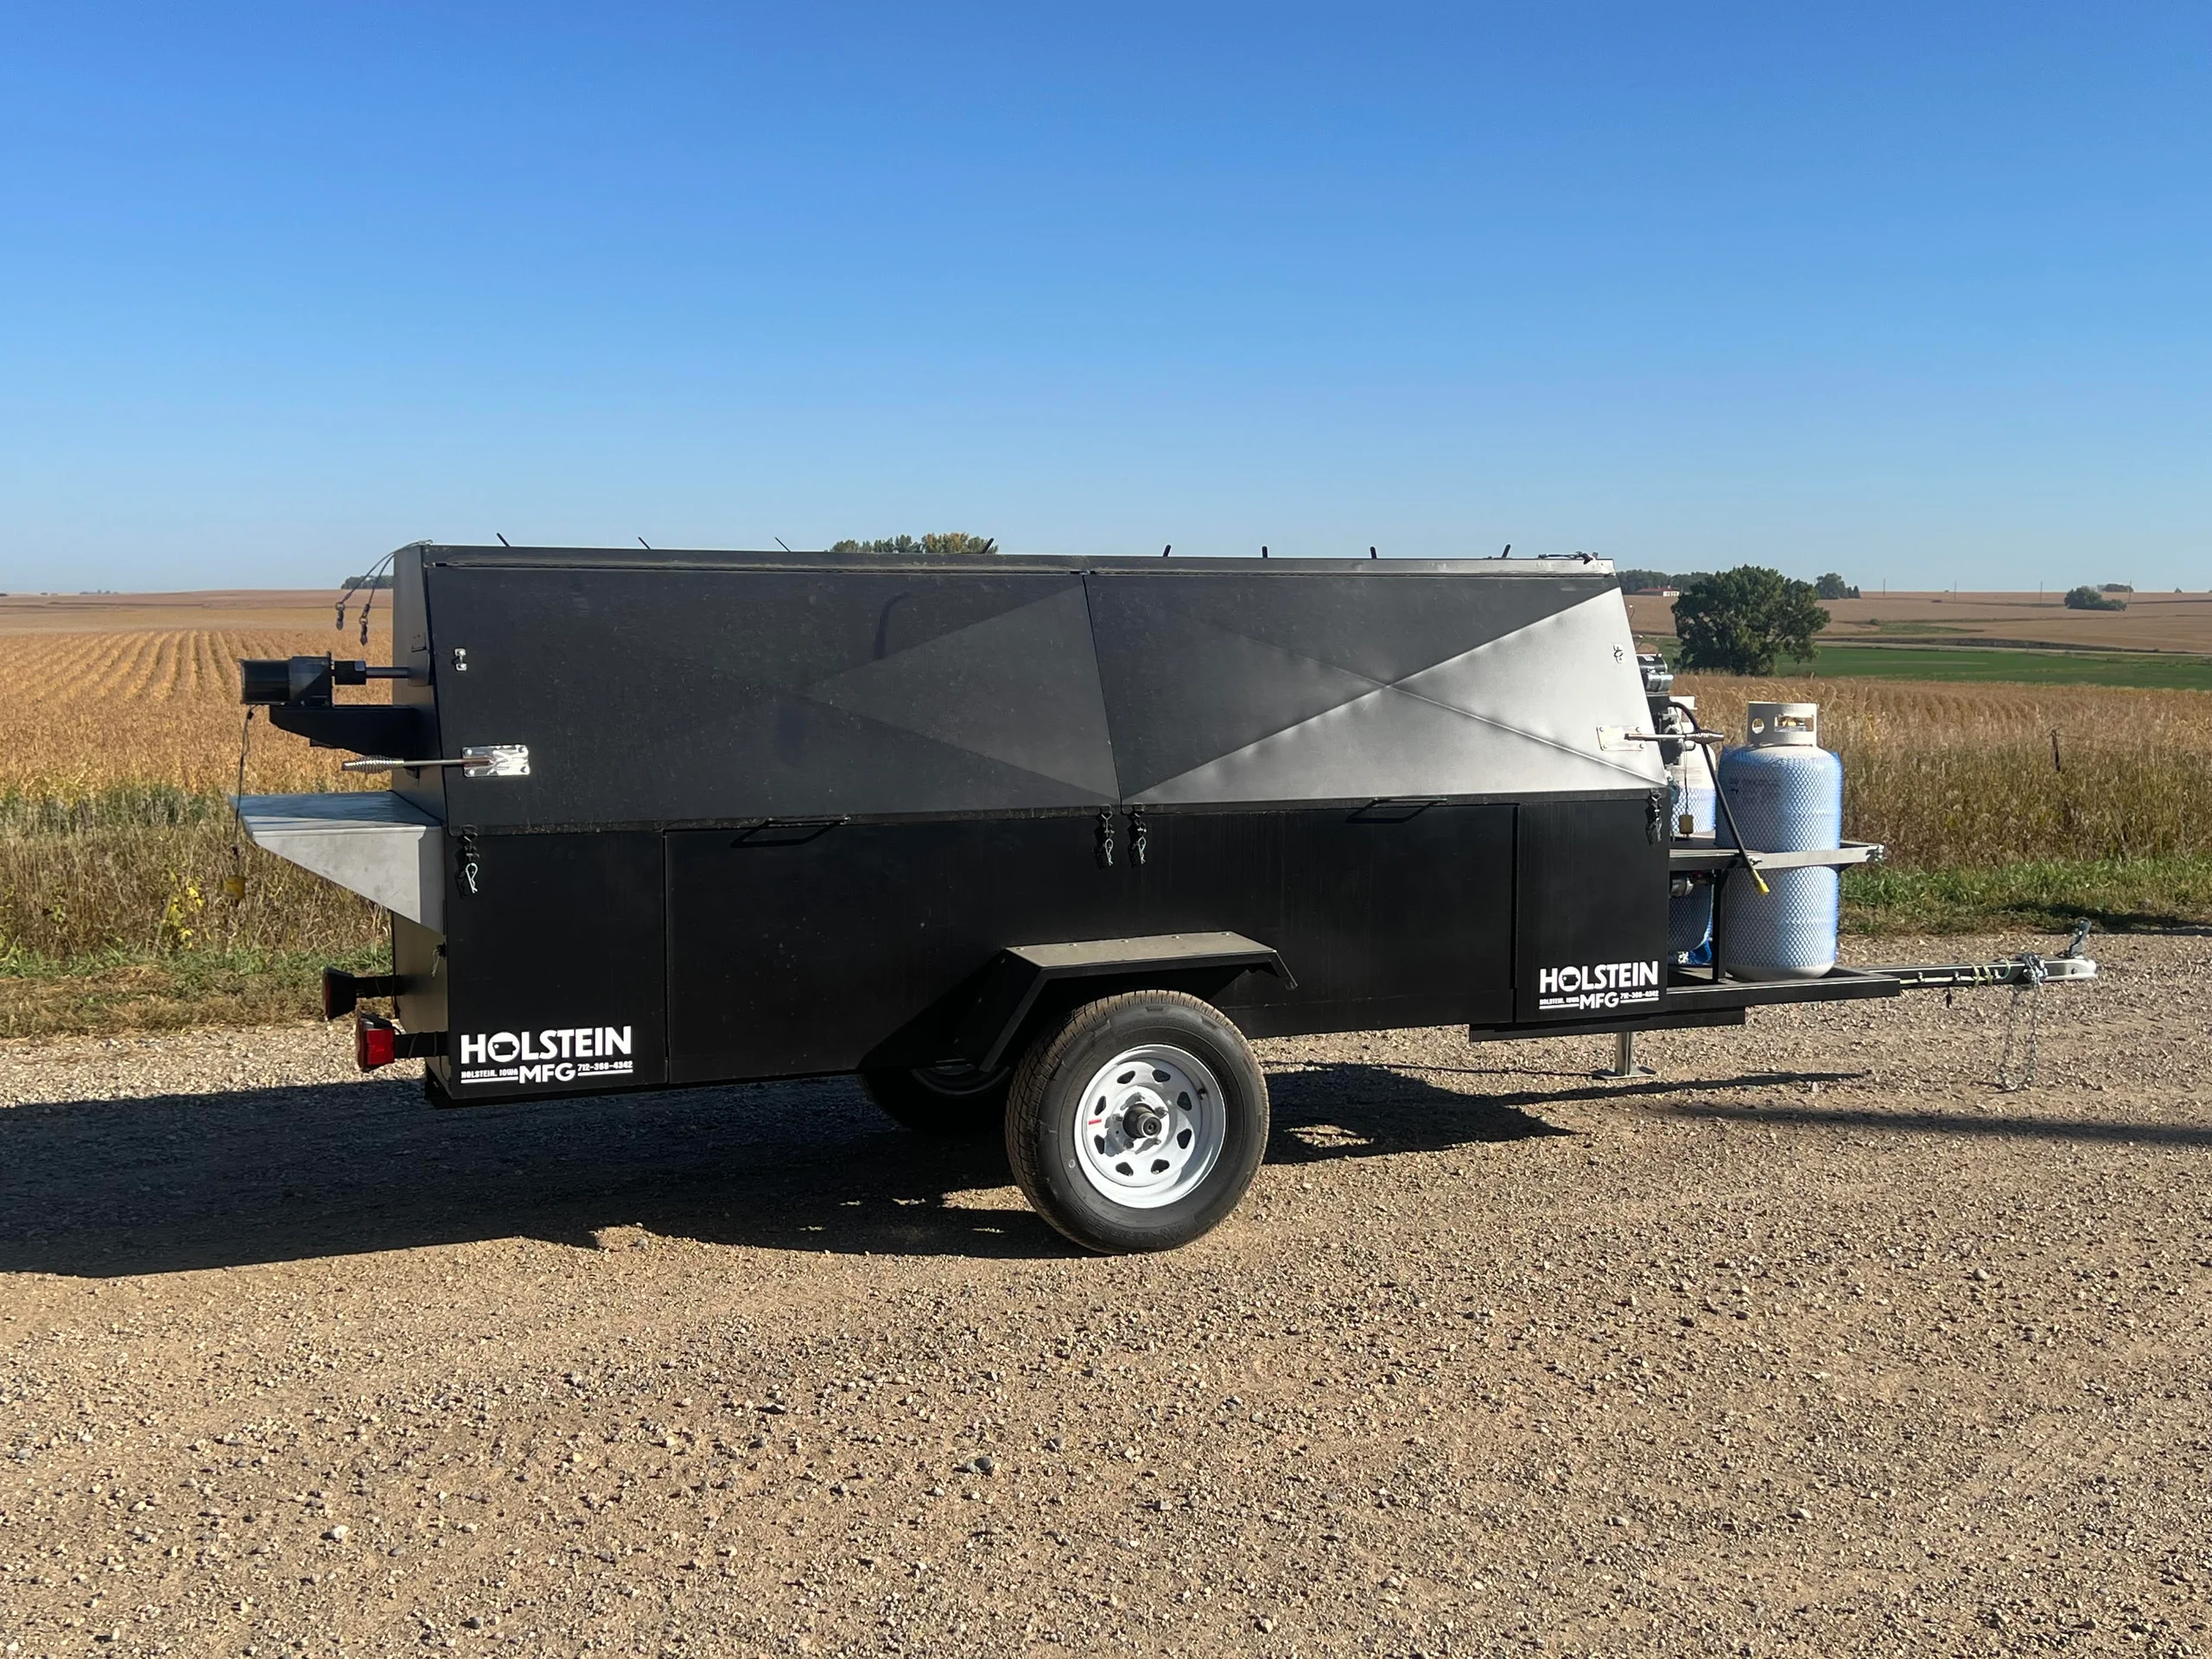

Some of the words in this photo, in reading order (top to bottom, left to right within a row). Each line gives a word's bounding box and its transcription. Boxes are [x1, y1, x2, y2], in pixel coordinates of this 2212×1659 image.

[1539, 961, 1659, 994] HOLSTEIN
[1580, 991, 1618, 1010] MFG
[461, 1026, 632, 1065] HOLSTEIN
[499, 1068, 518, 1077] IOWA
[518, 1062, 576, 1084] MFG
